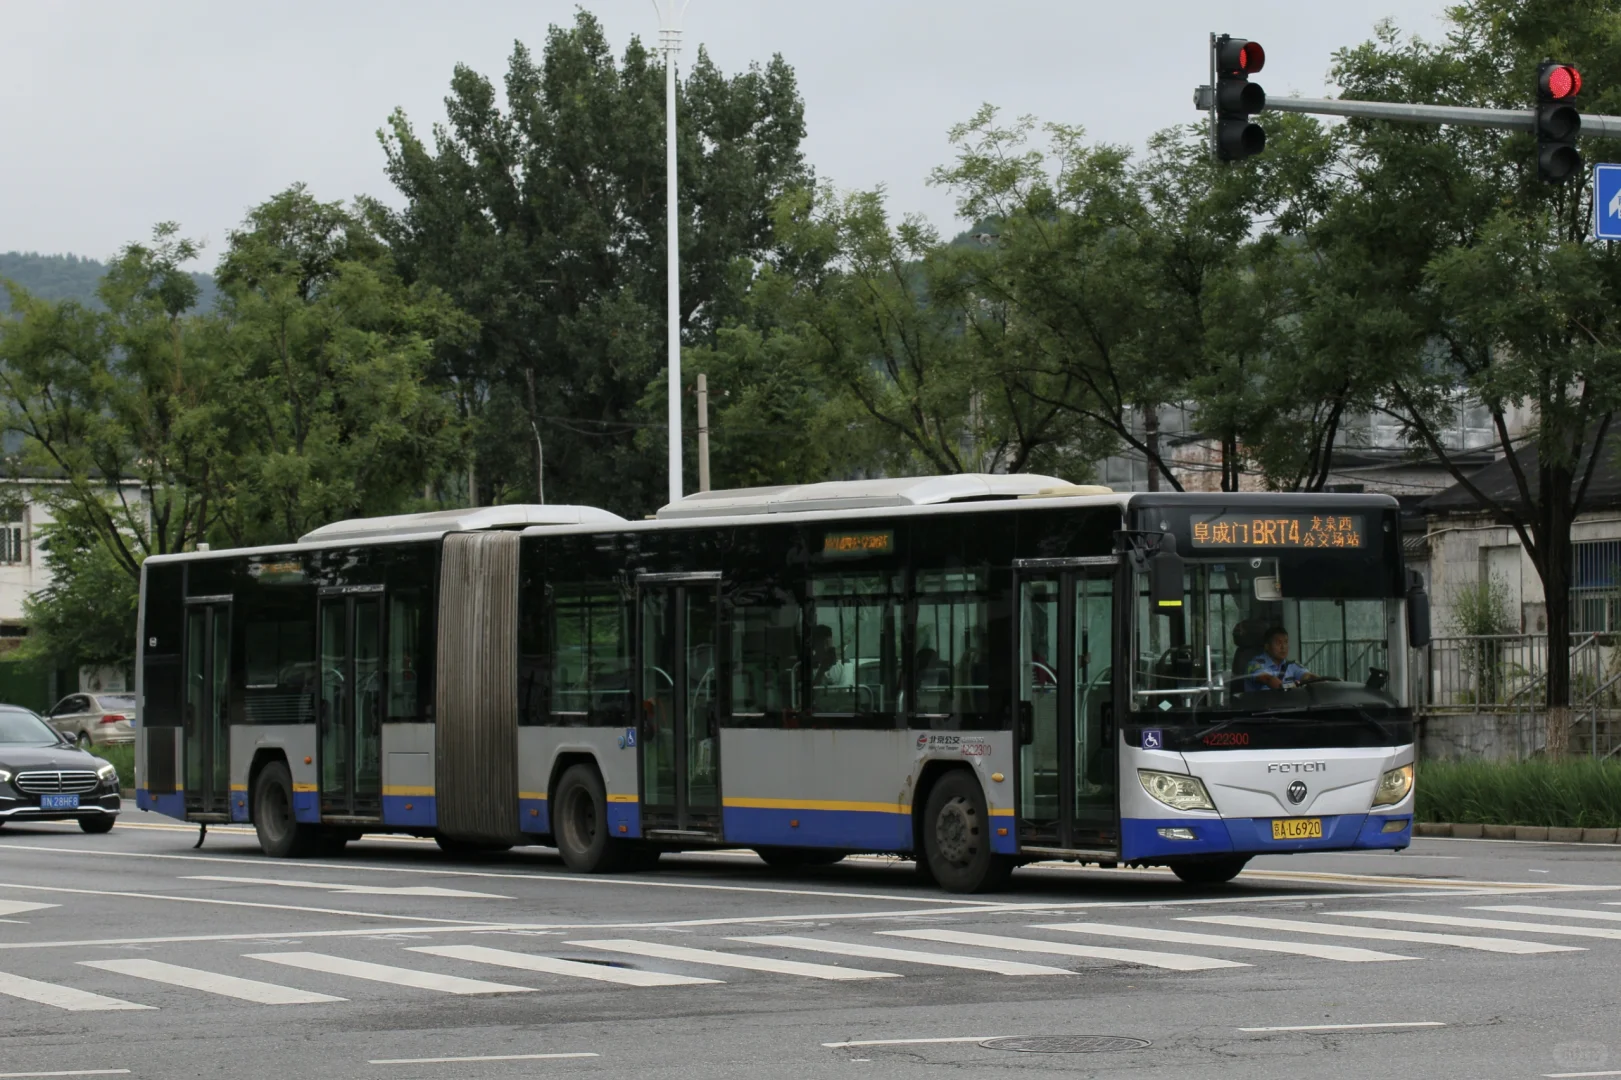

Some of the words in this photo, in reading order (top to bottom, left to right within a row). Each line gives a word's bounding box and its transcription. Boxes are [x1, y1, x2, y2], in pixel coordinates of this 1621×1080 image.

[1193, 521, 1248, 544] 阜成门
[1252, 519, 1299, 545] BRT4
[1310, 515, 1353, 532] 龙泉西
[1303, 531, 1360, 548] 公交场站
[1202, 732, 1249, 746] 4222300
